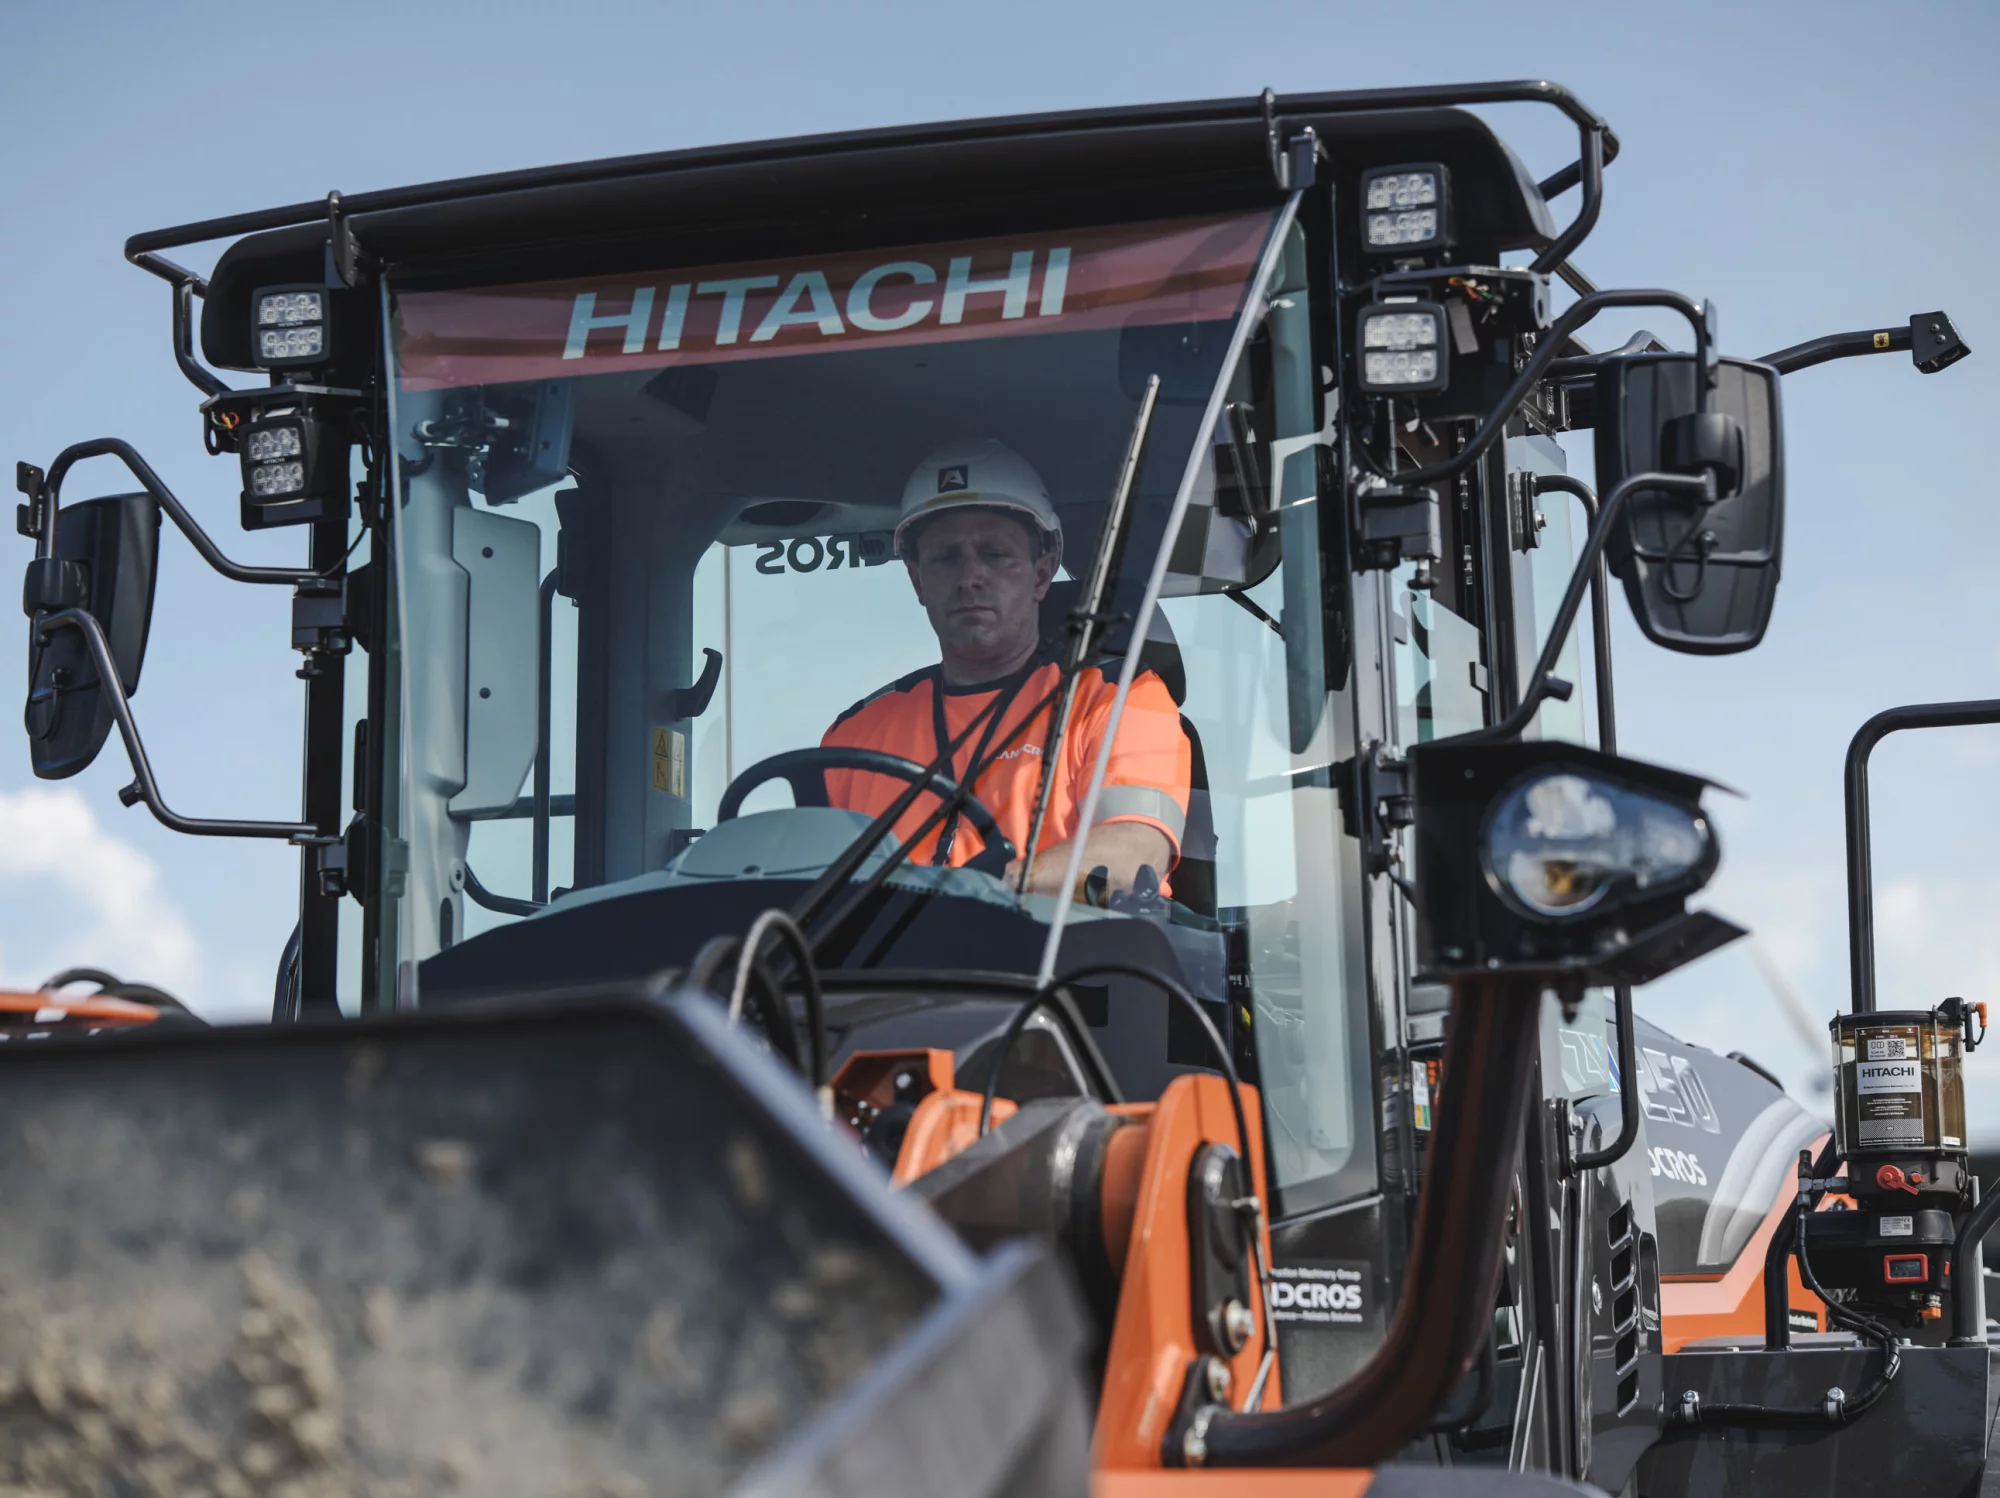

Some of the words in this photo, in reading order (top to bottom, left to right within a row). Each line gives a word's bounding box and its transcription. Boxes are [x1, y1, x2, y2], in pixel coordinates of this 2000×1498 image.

[562, 247, 1072, 361] HITACHI
[1862, 1067, 1914, 1078] HITACHI
[1270, 1282, 1362, 1309] DCROS
